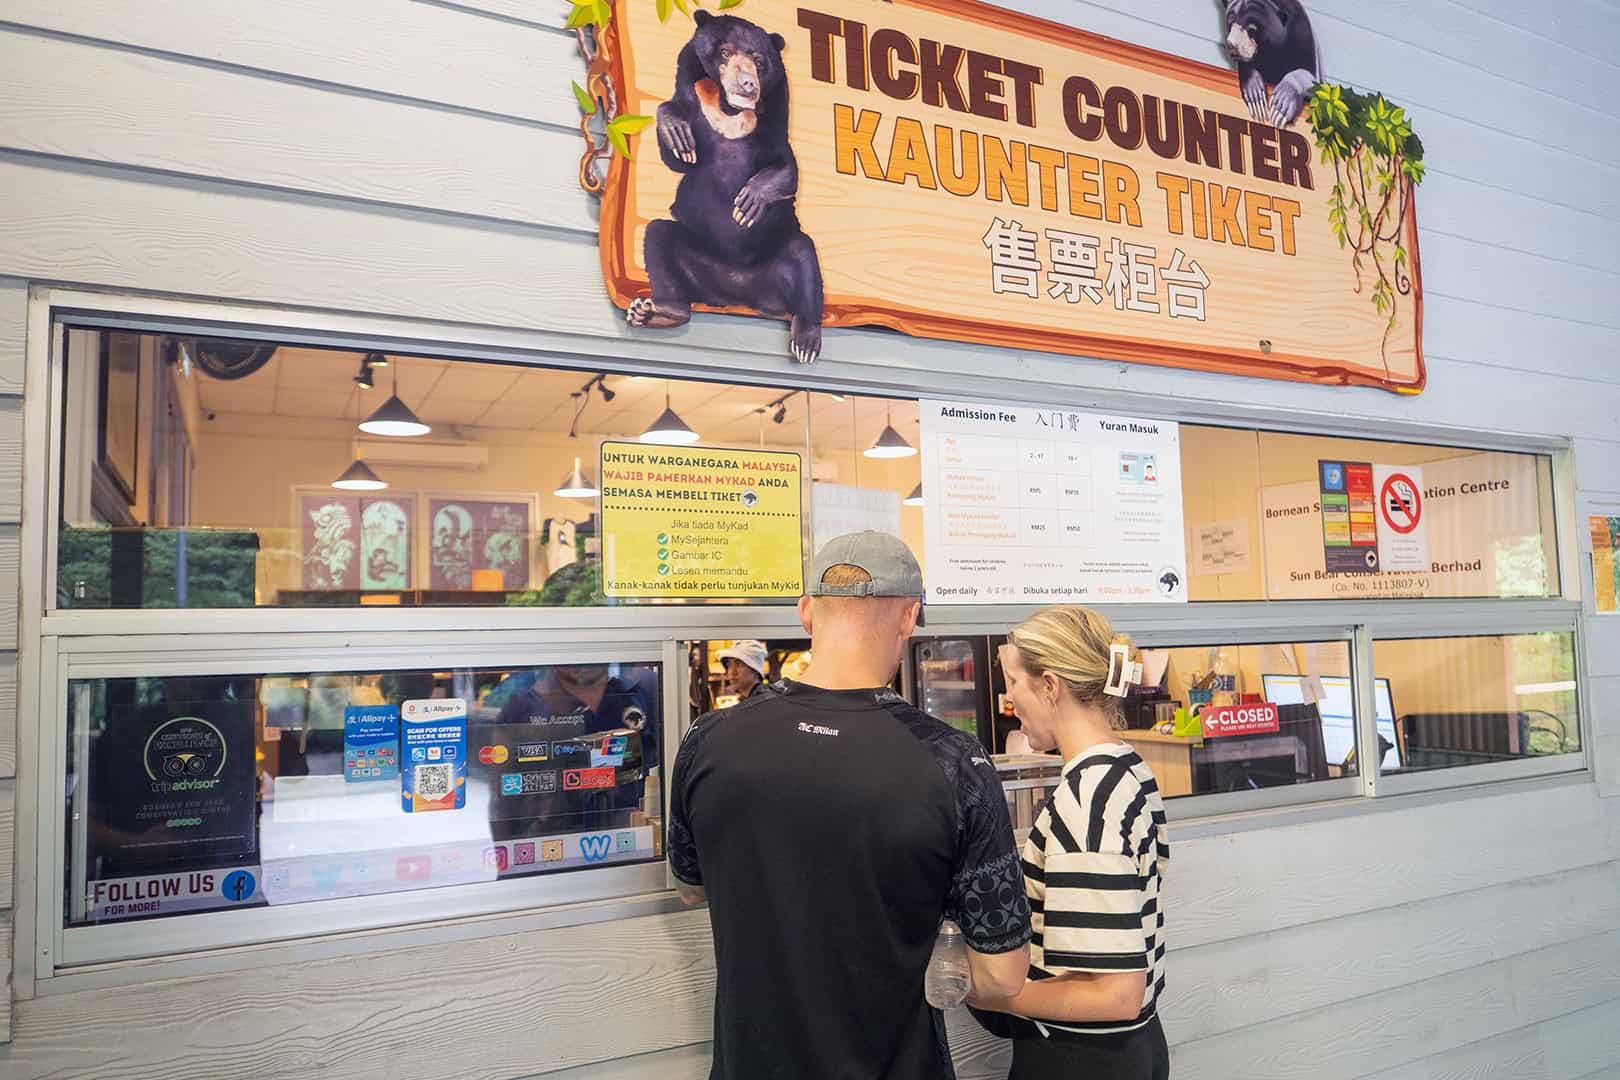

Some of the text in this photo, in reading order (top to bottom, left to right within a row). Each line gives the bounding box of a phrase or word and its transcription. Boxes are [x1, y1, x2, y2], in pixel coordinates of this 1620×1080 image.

[797, 8, 1315, 190] TICKET COUNTER
[834, 103, 1301, 256] KAUNTER TIKET
[982, 217, 1210, 321] 售票柜台
[941, 407, 1016, 423] Admission Fee
[1035, 411, 1079, 432] 入门费
[1099, 420, 1159, 435] Yuran Masuk
[603, 453, 798, 473] UNTUK WARGANEGARA MALAYSIA
[604, 470, 789, 488] WAJIB PAMERKAN MYKAD ANDA
[603, 487, 741, 502] SEMASA MEMBELI TIKET
[1460, 478, 1510, 496] Centre
[1265, 505, 1310, 519] Bornean
[671, 519, 689, 529] Jika
[717, 521, 748, 532] MyKad
[671, 535, 729, 547] MySejahtera
[671, 550, 709, 560] Gambar
[1290, 570, 1311, 582] Sun
[1431, 559, 1481, 574] Berhad
[607, 580, 800, 593] Kanak-kanak tidak perlu tunjukan MyKid
[936, 586, 957, 597] Open
[959, 585, 978, 597] daily
[1023, 586, 1049, 595] Dibuka
[1050, 585, 1072, 596] setiap
[1073, 585, 1088, 594] hari
[1219, 708, 1274, 725] CLOSED
[151, 779, 215, 794] tripadvisor
[94, 873, 215, 904] FOLLOW US
[104, 901, 161, 916] FOR MORE!
